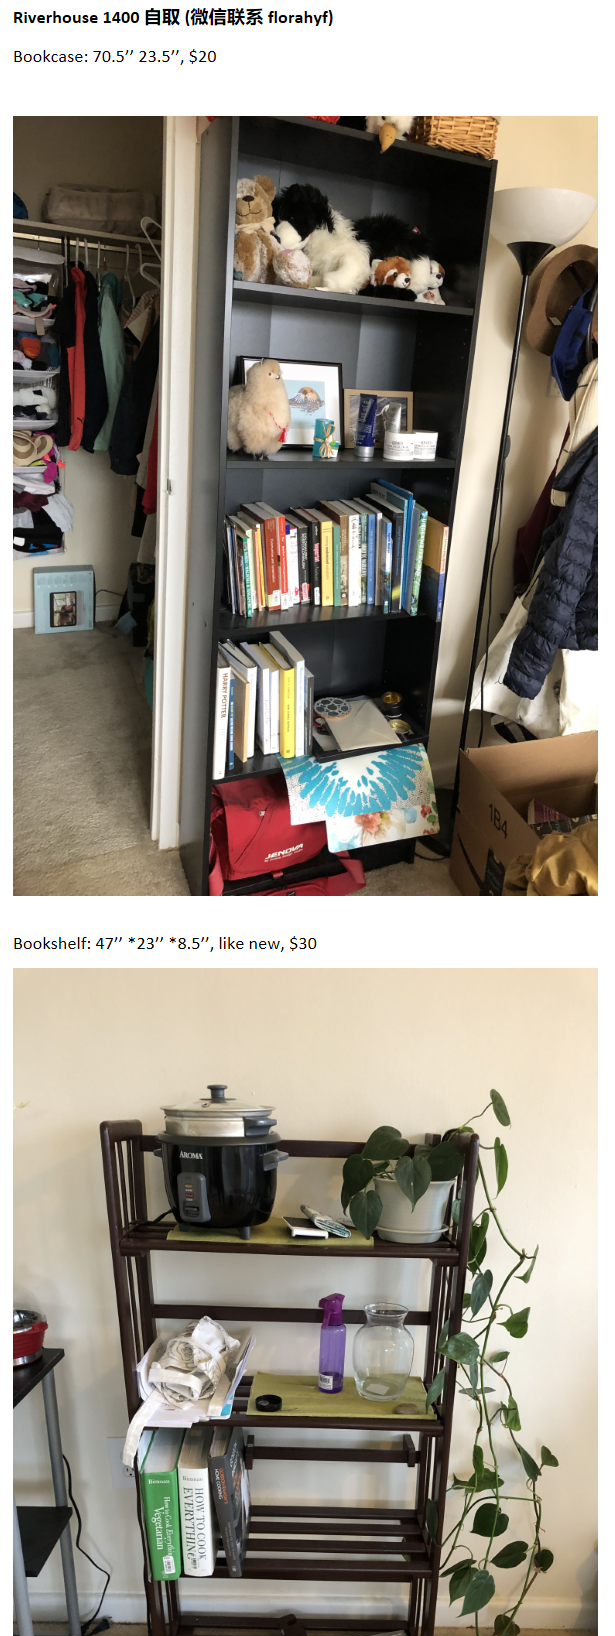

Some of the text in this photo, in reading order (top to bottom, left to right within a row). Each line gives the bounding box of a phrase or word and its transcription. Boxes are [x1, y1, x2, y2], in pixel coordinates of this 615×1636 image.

[489, 803, 508, 840] 1B4
[265, 843, 304, 860] JENOVA
[179, 1150, 203, 1160] AROMA
[215, 1480, 223, 1500] COOKING
[151, 1506, 167, 1550] Vegetarian
[194, 1487, 207, 1560] HOW TO COOK
[165, 1529, 175, 1557] Everythin
